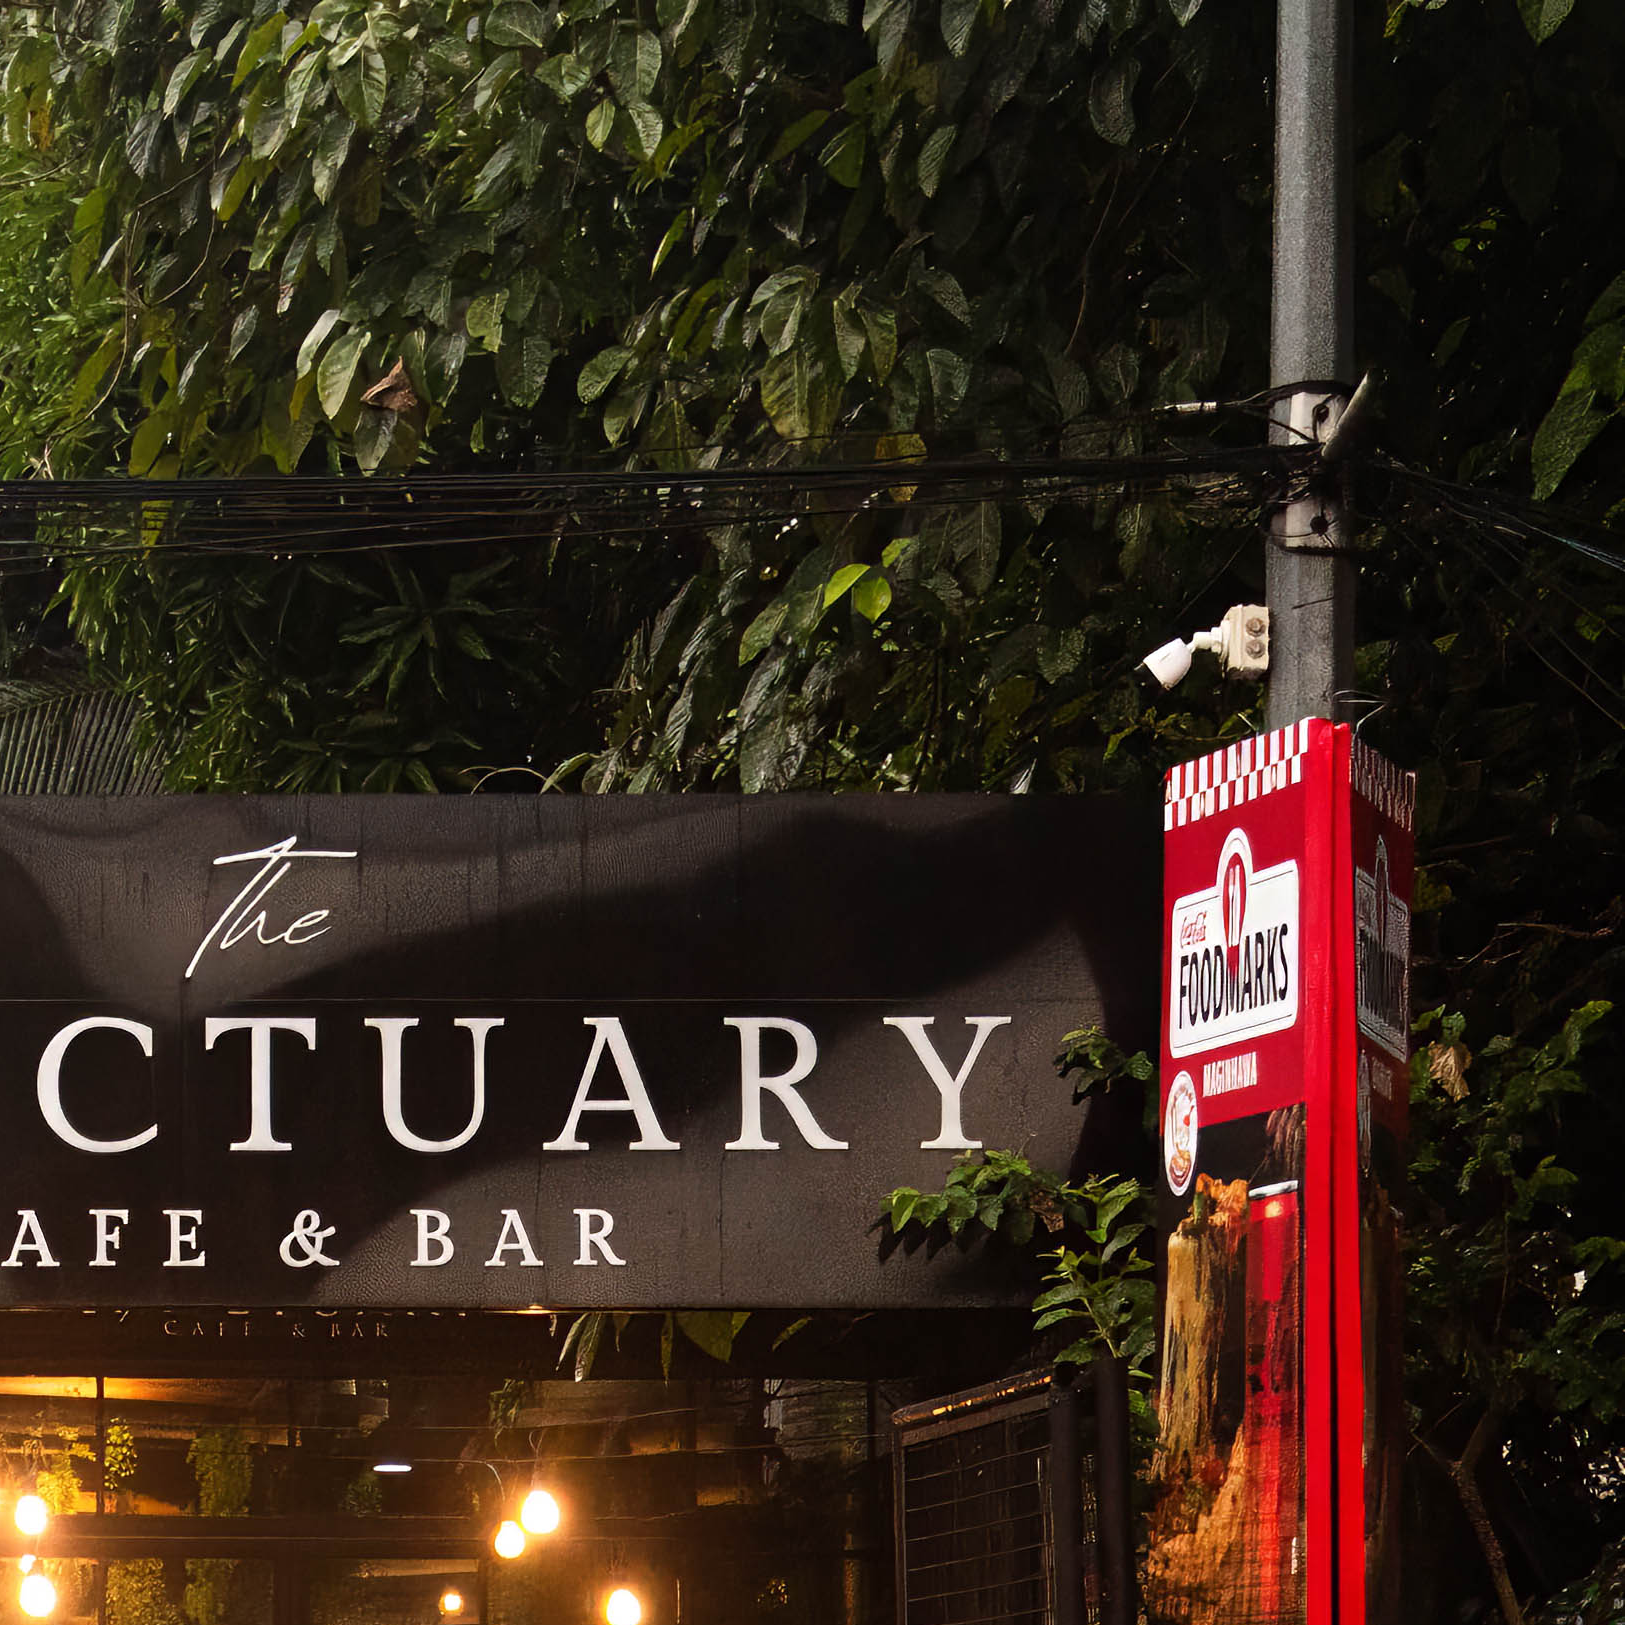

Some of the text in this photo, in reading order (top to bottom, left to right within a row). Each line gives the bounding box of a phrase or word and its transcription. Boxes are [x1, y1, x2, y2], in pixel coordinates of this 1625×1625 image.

[185, 836, 357, 977] The
[1179, 924, 1288, 1029] FOODMARKS
[280, 1210, 340, 1267] &
[410, 1209, 626, 1266] BAR
